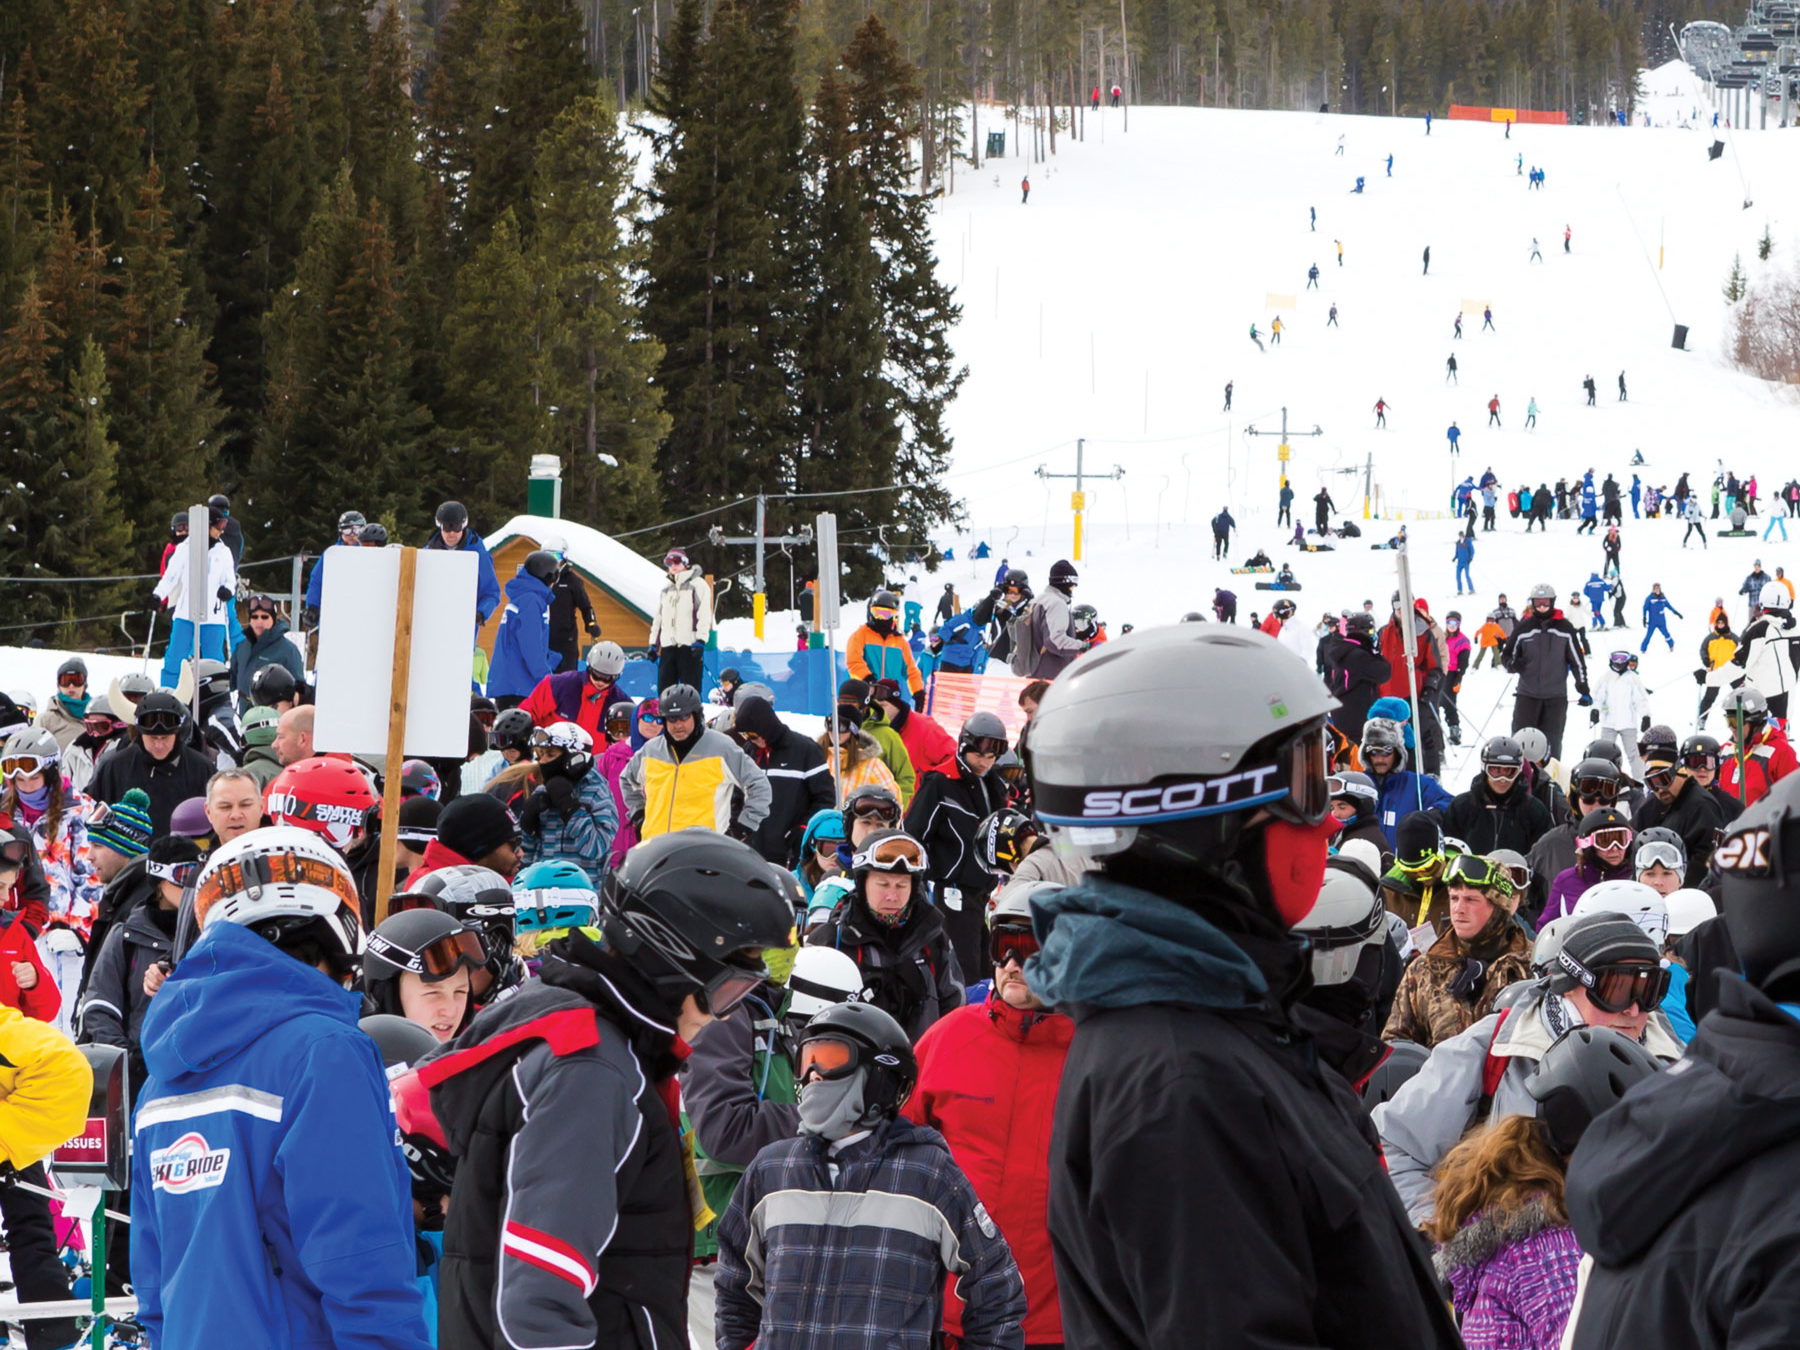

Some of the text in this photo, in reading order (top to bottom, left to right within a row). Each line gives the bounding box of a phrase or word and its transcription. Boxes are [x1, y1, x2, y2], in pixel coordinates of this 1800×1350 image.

[1082, 764, 1279, 817] SCOTT
[316, 804, 363, 819] SMITH
[1714, 831, 1770, 870] ex
[1558, 951, 1583, 979] COTT
[59, 1137, 102, 1149] ISSUES
[174, 1162, 184, 1177] &
[186, 1153, 224, 1177] RIDE
